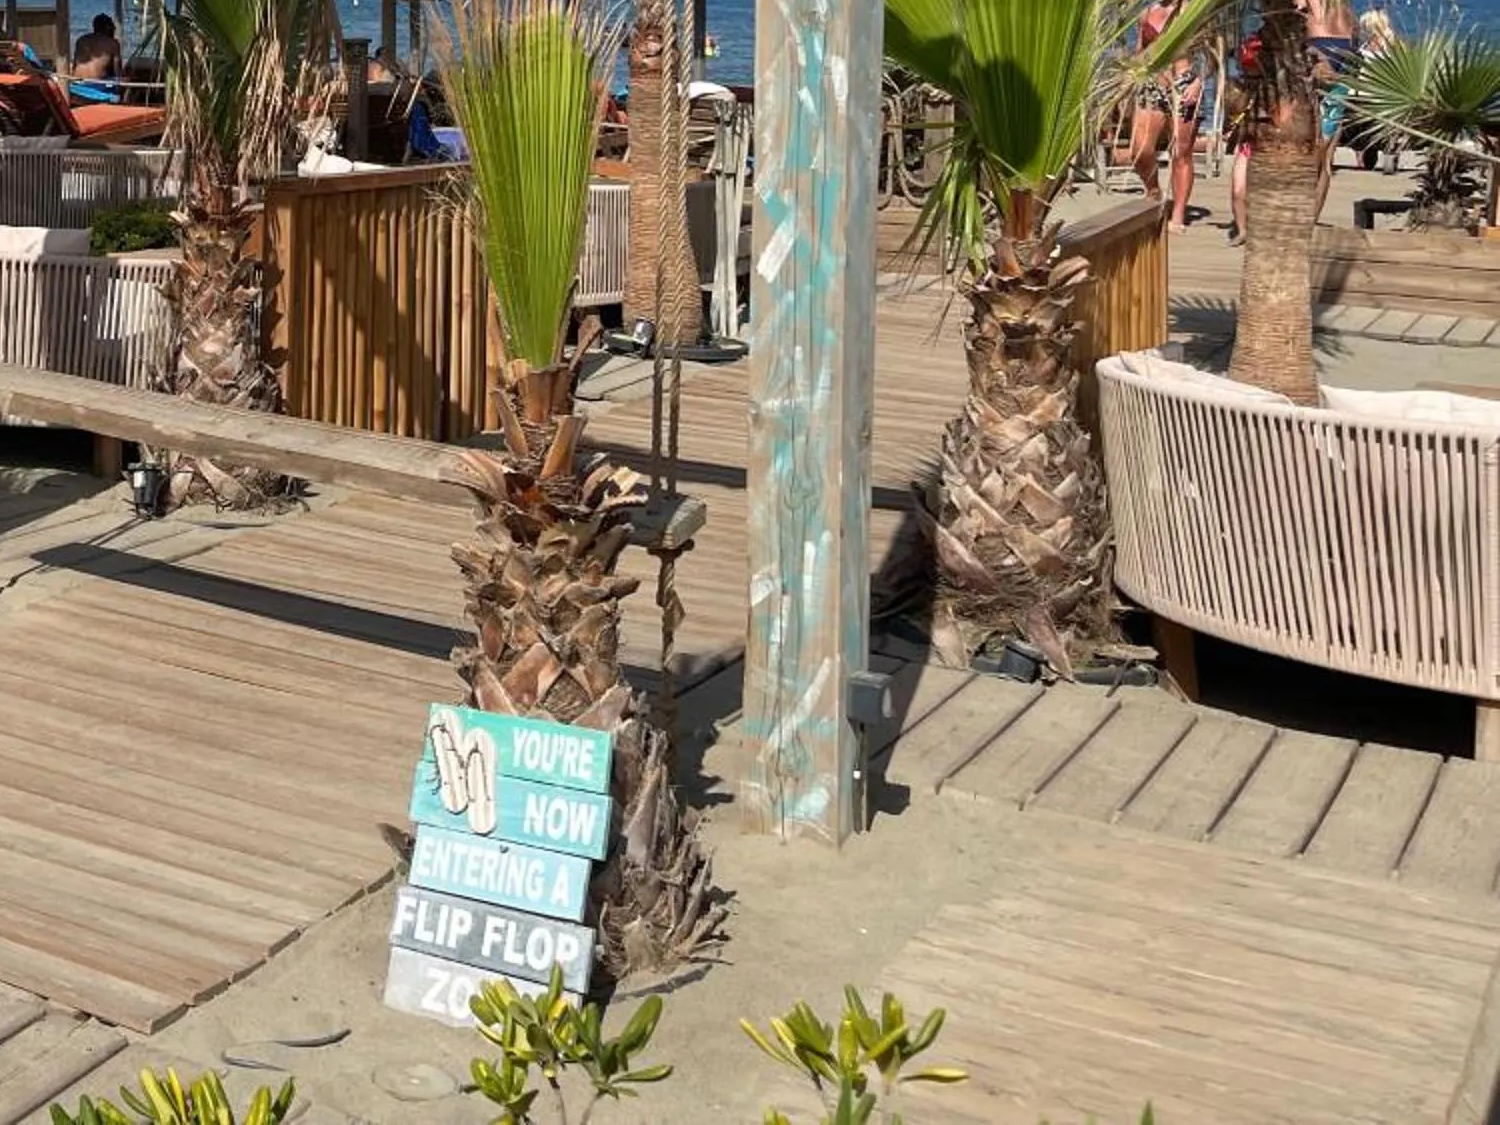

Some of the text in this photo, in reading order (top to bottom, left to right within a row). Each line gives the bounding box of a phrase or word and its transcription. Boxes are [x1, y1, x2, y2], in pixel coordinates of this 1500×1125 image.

[511, 729, 596, 777] YOU'RE
[523, 793, 598, 846] NOW
[415, 835, 571, 907] ENTERING A
[391, 894, 580, 971] FLIP FLOP
